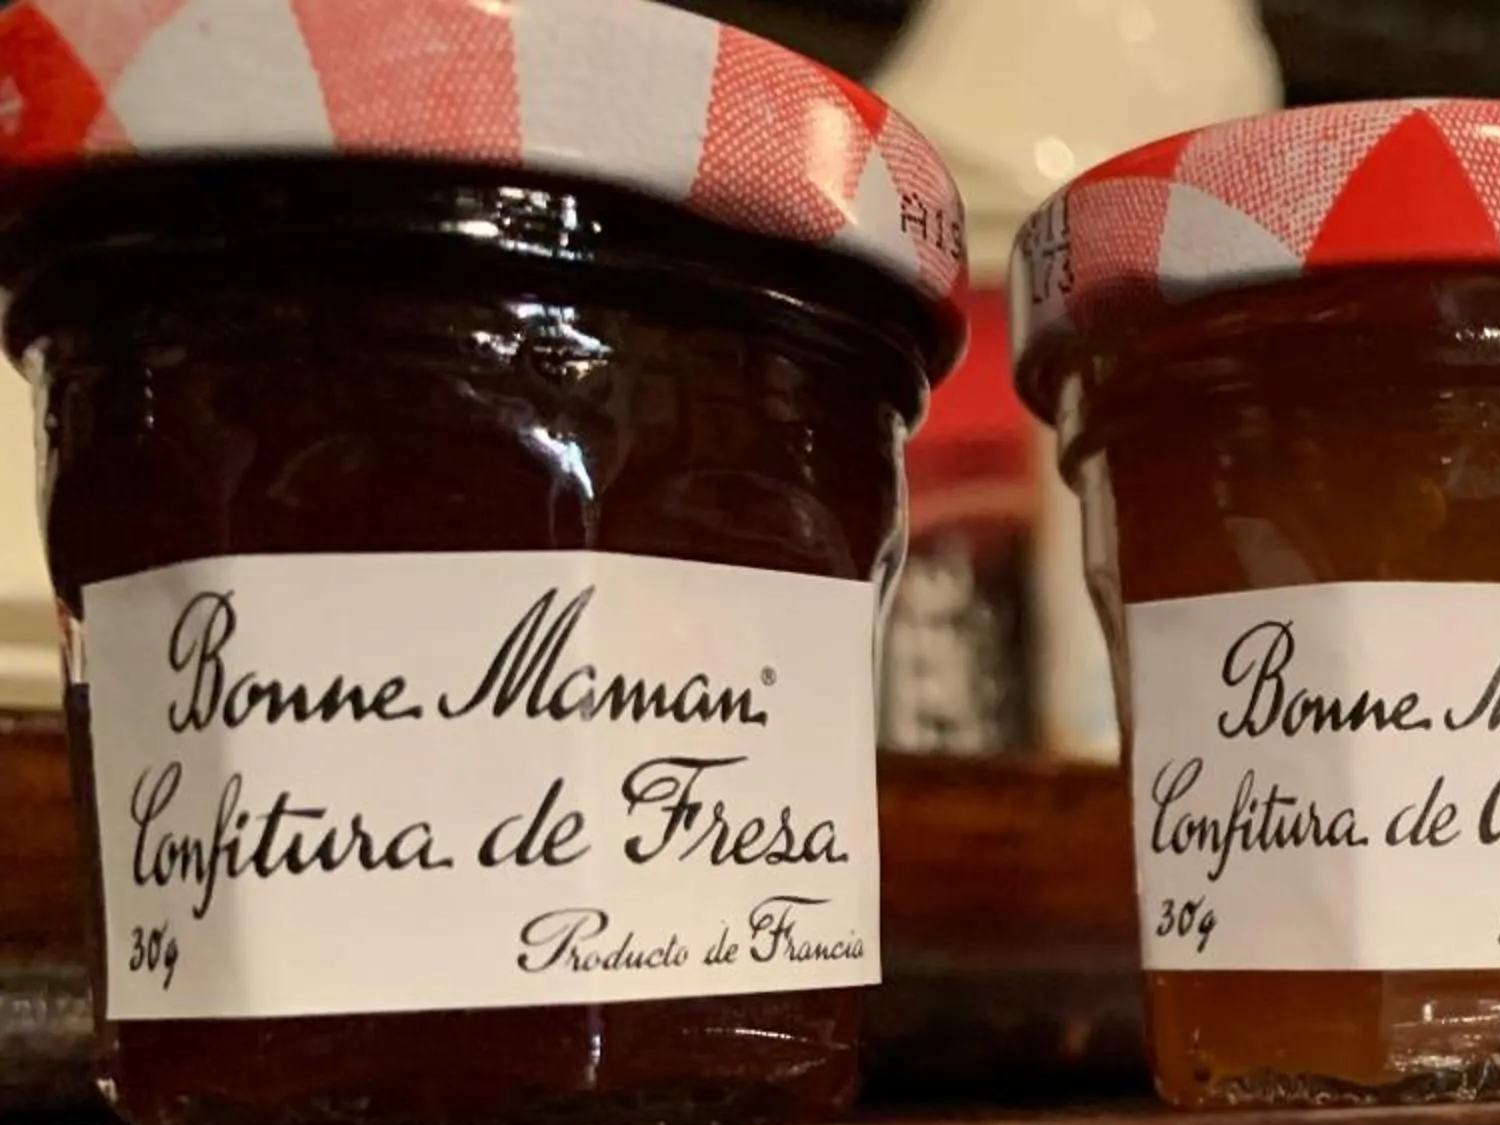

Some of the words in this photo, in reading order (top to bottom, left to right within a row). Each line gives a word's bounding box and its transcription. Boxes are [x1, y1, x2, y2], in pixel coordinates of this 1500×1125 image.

[168, 590, 423, 733] Bonne
[1218, 620, 1432, 738] Bonne
[130, 761, 453, 919] Confitura
[478, 777, 591, 869] de
[621, 755, 849, 867] Fresa
[1151, 757, 1368, 881] Confitura
[1385, 775, 1460, 848] de
[518, 906, 689, 974] Producto
[703, 920, 738, 966] de
[747, 895, 864, 964] Francia
